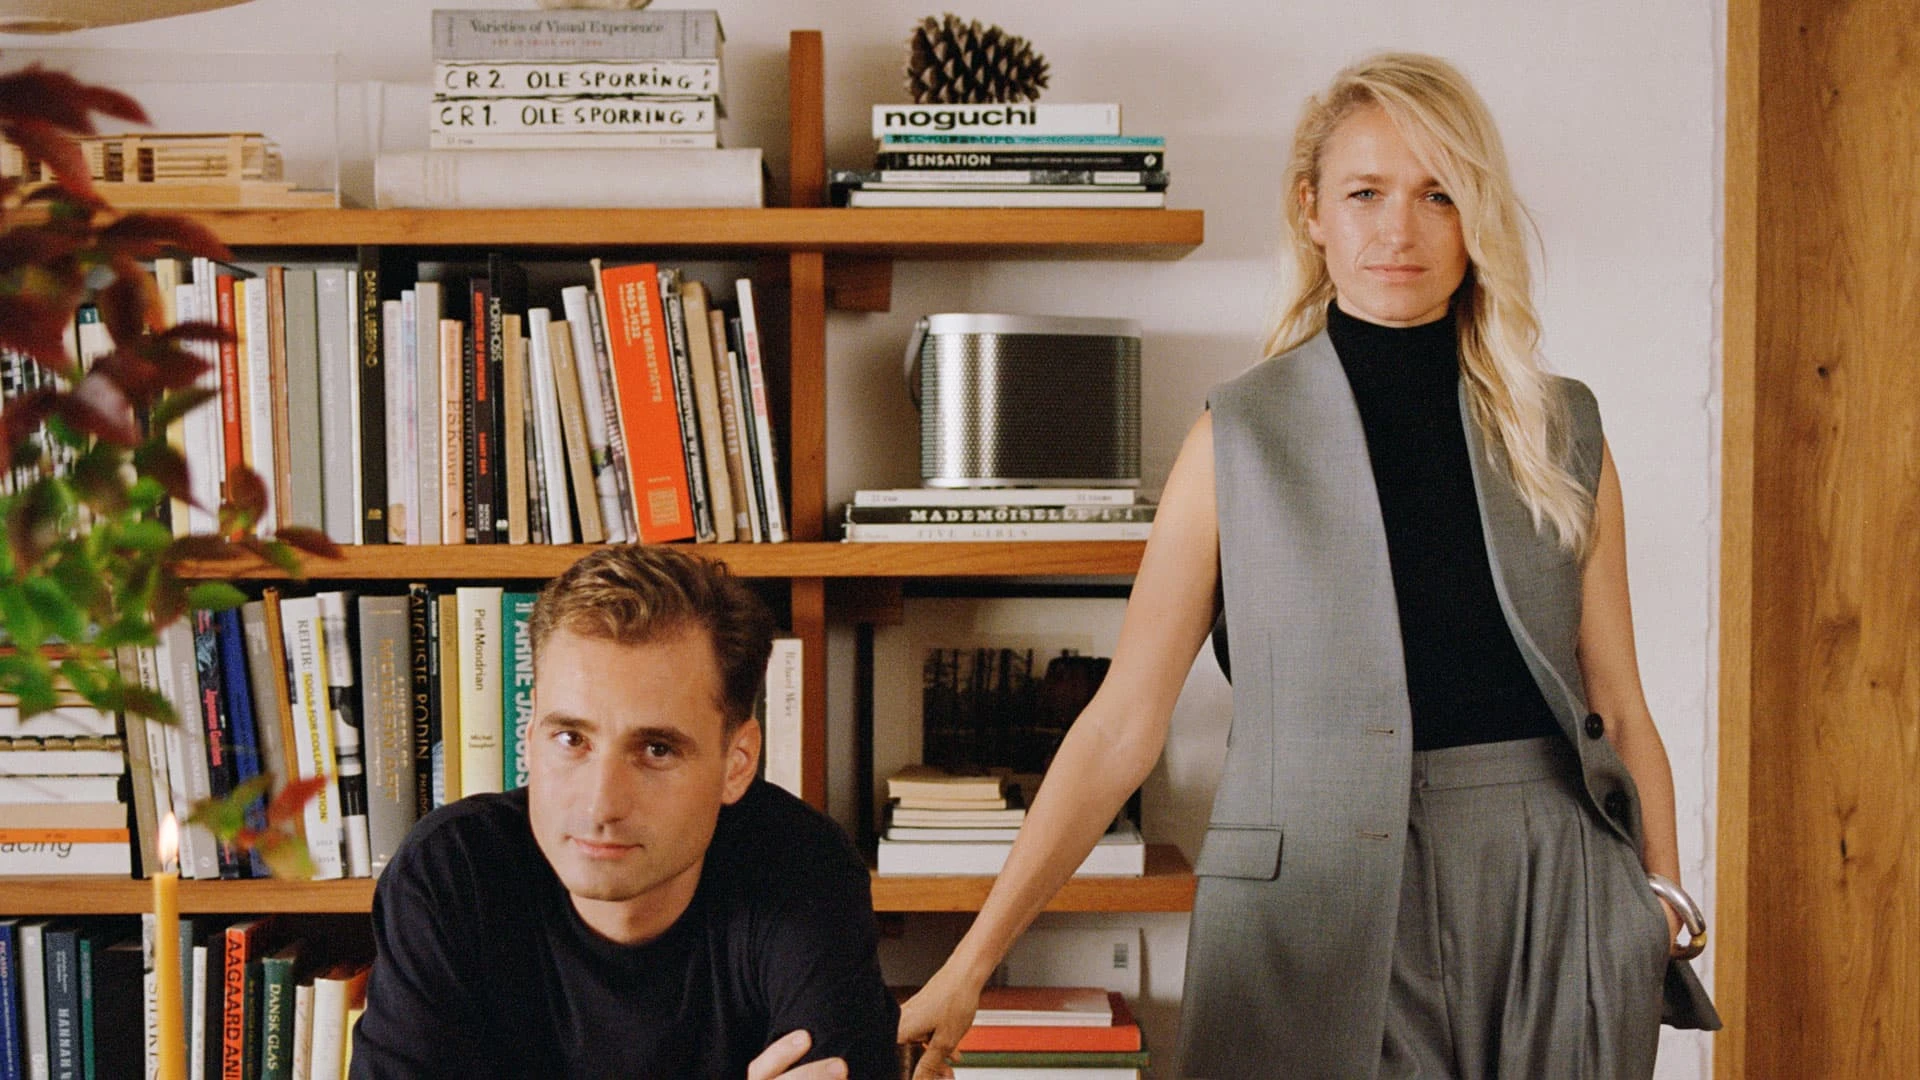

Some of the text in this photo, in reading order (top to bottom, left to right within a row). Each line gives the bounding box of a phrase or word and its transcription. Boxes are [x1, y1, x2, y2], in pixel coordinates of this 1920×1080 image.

[471, 19, 527, 33] Varieties
[529, 19, 543, 33] of
[545, 20, 588, 33] Visual
[590, 20, 664, 36] Experience
[527, 69, 571, 89] OLE
[521, 105, 566, 126] OLE
[884, 104, 1037, 130] noguchi
[907, 153, 992, 168] SENSATION
[364, 270, 378, 312] DANIEL
[635, 281, 651, 326] WIENER
[910, 508, 1088, 523] MADEMOISELLE
[475, 608, 487, 691] Piet Mondrian
[379, 638, 400, 804] MODERN ART
[411, 595, 430, 817] AUGUSTE RODIN PHAIDO
[310, 732, 328, 822] COLLABOATION
[226, 938, 242, 1041] AAGAARD
[57, 1008, 72, 1068] HANNAH
[268, 983, 281, 1070] DANSK GLAS
